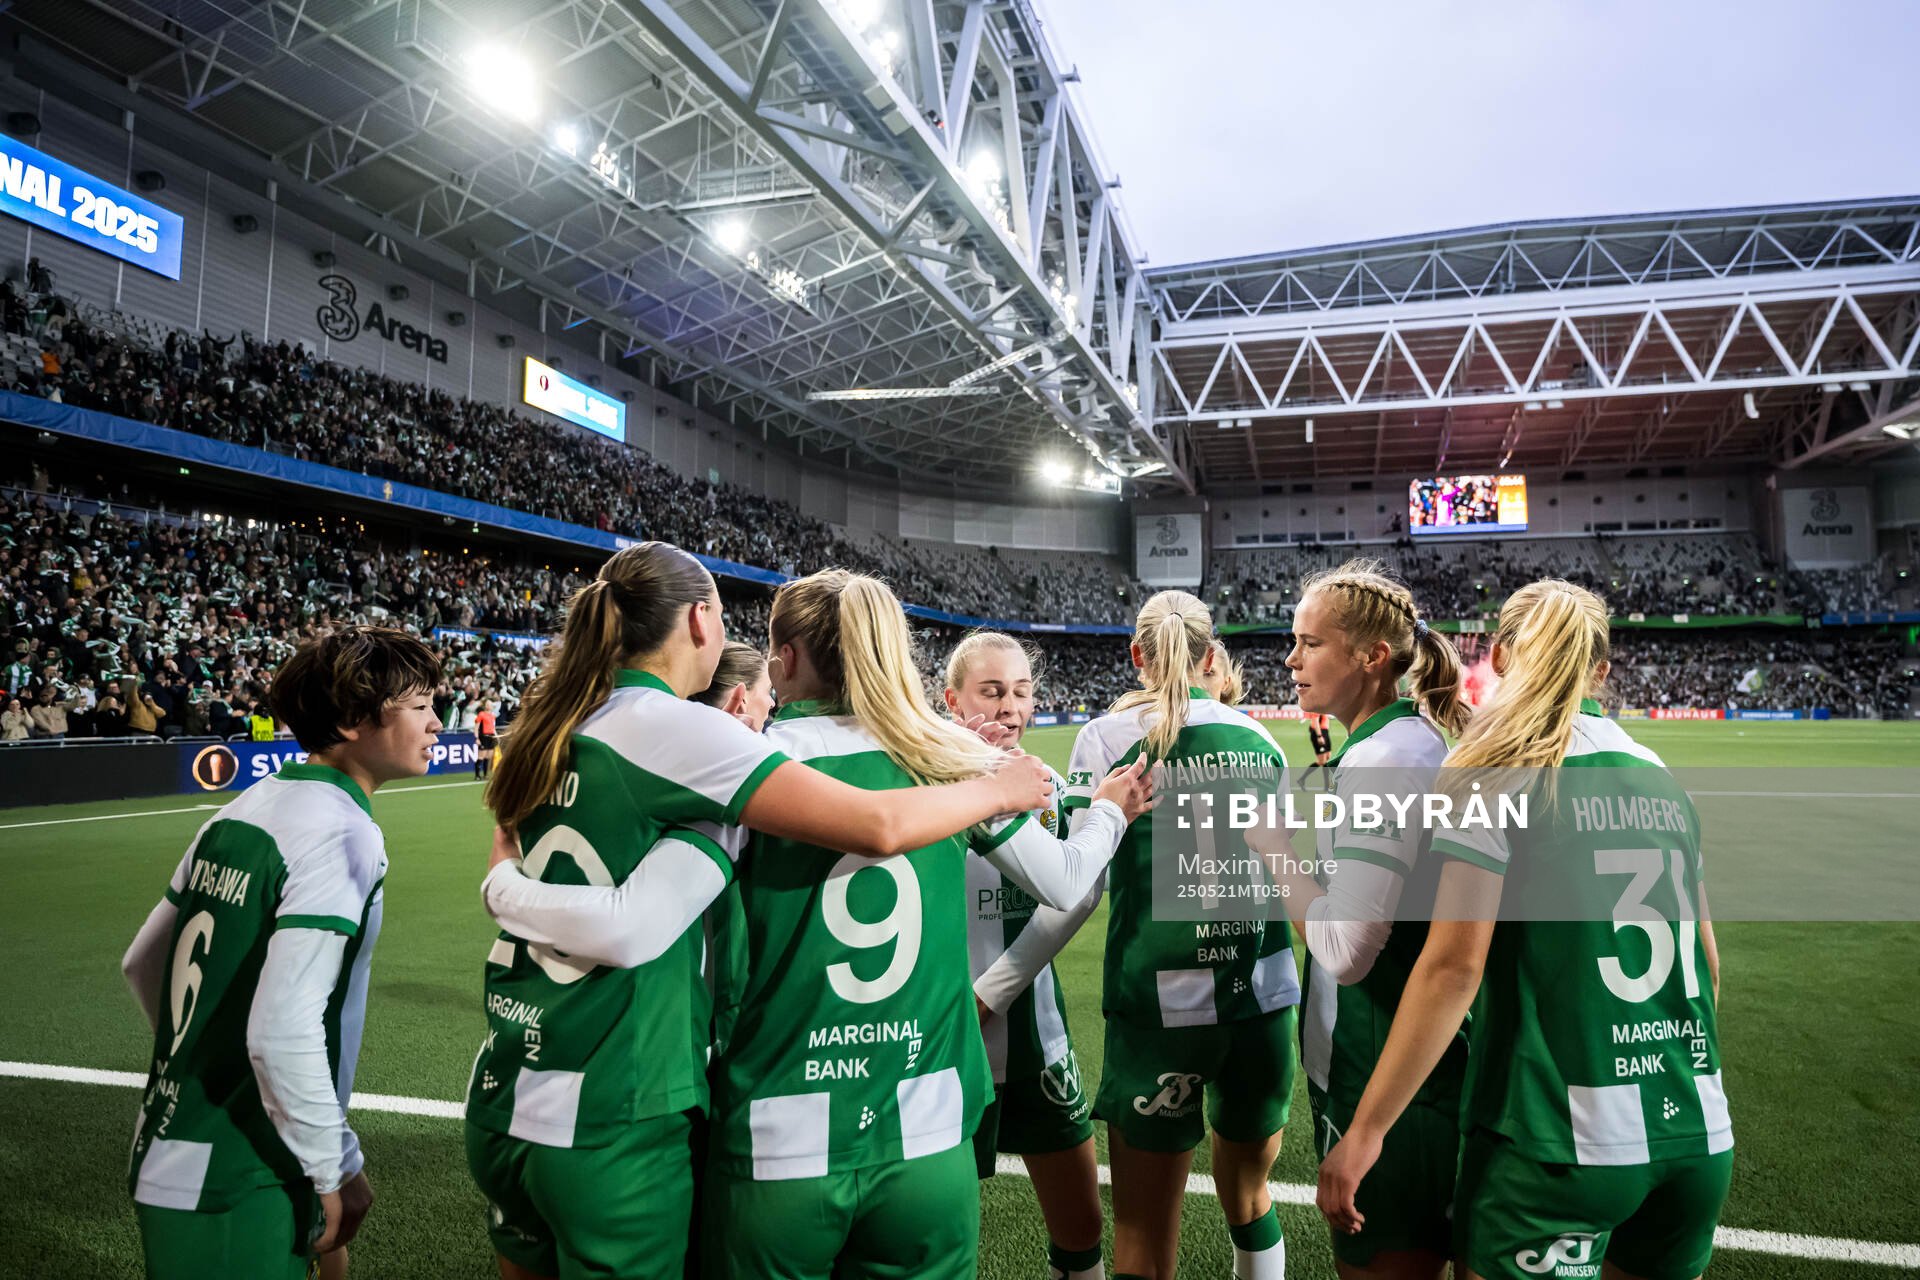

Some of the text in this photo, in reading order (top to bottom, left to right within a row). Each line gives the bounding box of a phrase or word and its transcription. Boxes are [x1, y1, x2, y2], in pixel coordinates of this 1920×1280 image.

[72, 186, 159, 254] 2025
[363, 302, 449, 364] Arena
[1802, 522, 1853, 536] Arena
[1148, 546, 1189, 558] Arena
[433, 744, 479, 766] PEN
[1572, 796, 1687, 833] HOLMBERG
[822, 854, 923, 1004] 9
[1196, 918, 1266, 939] MARGINA
[1593, 848, 1700, 1003] 31
[1197, 945, 1239, 962] BANK
[170, 910, 215, 1057] 6
[808, 1018, 923, 1049] MARGINAL
[1612, 1019, 1706, 1044] MARGINAL
[805, 1057, 870, 1081] BANK
[1615, 1054, 1665, 1077] BANK
[1555, 1265, 1600, 1278] MARKSERV
